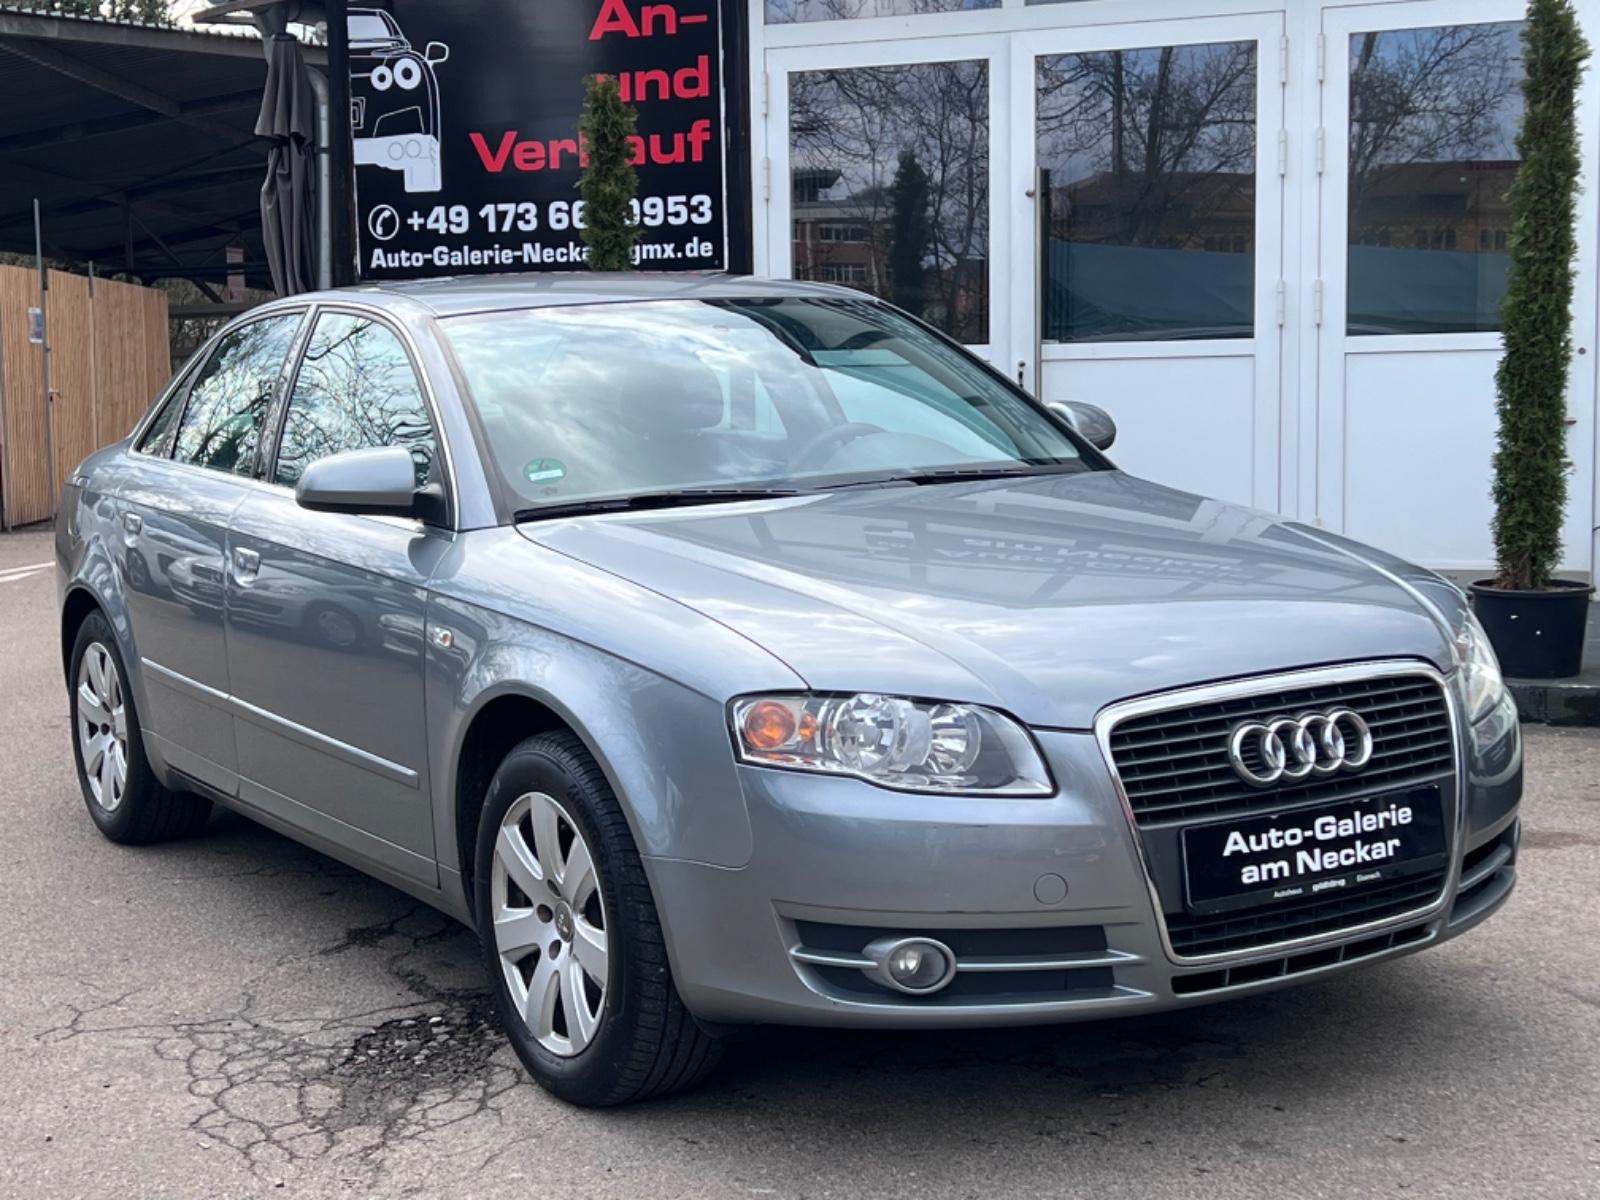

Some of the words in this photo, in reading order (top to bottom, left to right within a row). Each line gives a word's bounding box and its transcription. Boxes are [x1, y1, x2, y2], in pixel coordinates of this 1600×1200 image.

[589, 0, 708, 40] An-
[407, 204, 469, 234] +49
[478, 202, 538, 233] 173
[1222, 804, 1412, 856] Auto-Galerie
[1241, 859, 1290, 884] am
[1296, 838, 1400, 874] Neckar
